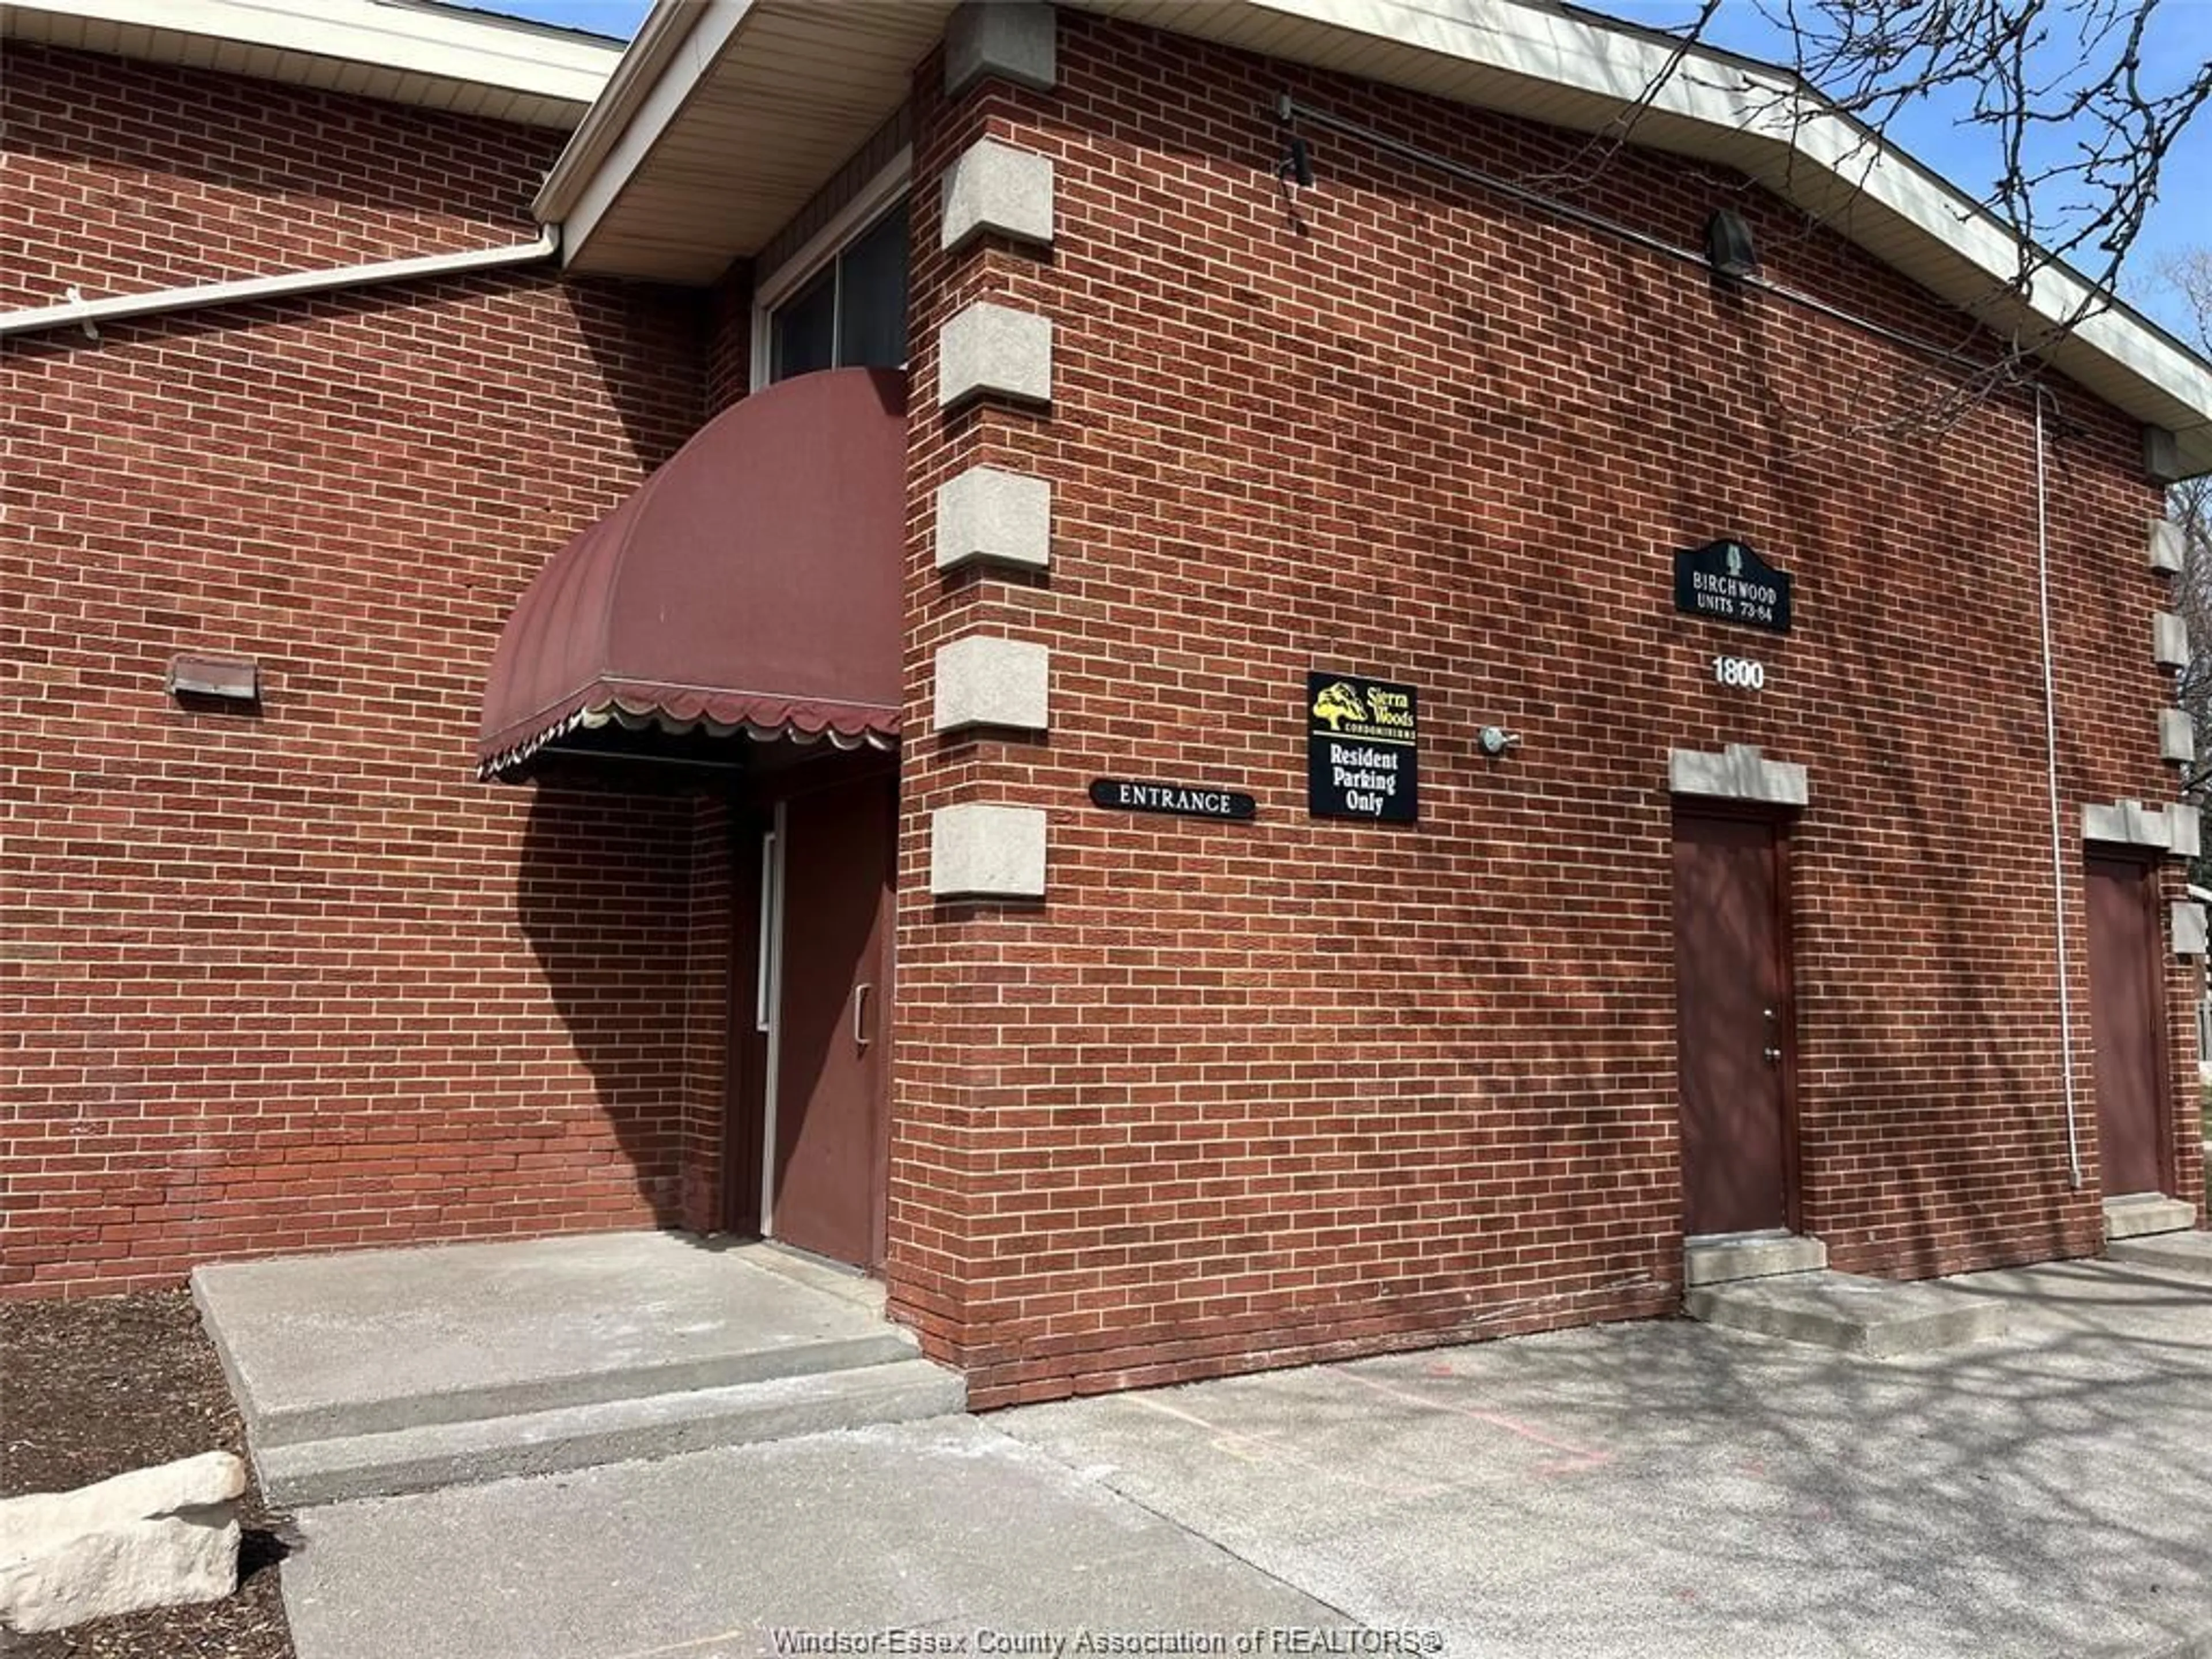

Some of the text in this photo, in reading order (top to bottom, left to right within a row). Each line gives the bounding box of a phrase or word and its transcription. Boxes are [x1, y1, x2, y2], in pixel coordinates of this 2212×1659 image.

[1693, 571, 1777, 605] BIRCHWOOD
[1698, 592, 1733, 615] UNITS
[1713, 656, 1764, 689] 1800
[1367, 687, 1408, 707] Sierra
[1373, 702, 1414, 727] Woods
[1330, 743, 1398, 770] Resident
[1333, 767, 1396, 796] Parking
[1120, 784, 1231, 813] ENTRANCE
[1346, 790, 1383, 816] Only
